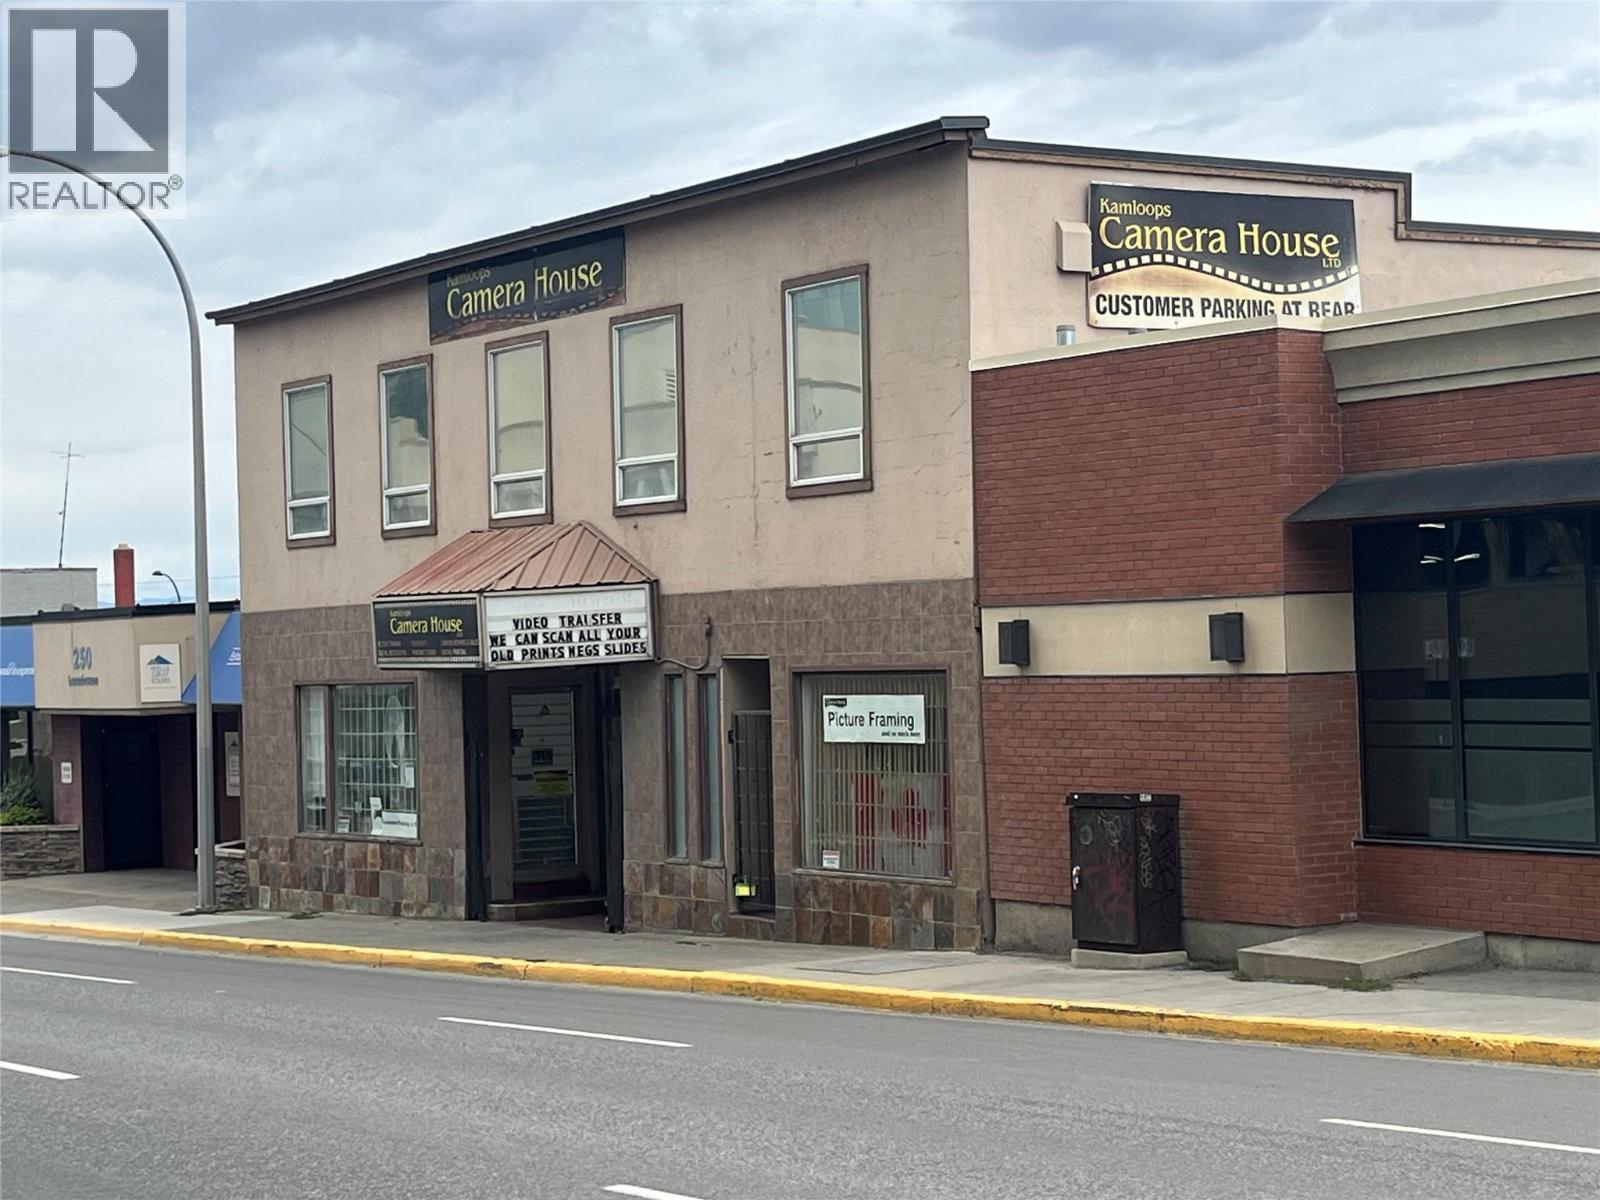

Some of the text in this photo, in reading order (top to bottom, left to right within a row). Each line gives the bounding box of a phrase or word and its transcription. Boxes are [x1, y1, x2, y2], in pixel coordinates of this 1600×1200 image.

[1100, 198, 1172, 220] Kamloops
[1100, 216, 1341, 258] Camera House
[1322, 258, 1342, 268] LTD
[447, 261, 603, 319] Camera House
[1096, 293, 1194, 317] CUSTOMER
[1201, 298, 1275, 318] PARKING
[1281, 301, 1302, 316] AT
[390, 616, 463, 635] Camera House
[513, 616, 548, 630] VIDEO
[515, 632, 538, 646] CAN
[542, 630, 573, 644] SCAN
[578, 628, 601, 643] ALL
[607, 627, 641, 640] YOUR
[73, 646, 93, 670] 250
[521, 646, 565, 661] PRINTS
[568, 644, 600, 658] NEGS
[604, 642, 647, 656] SLIDES
[828, 711, 915, 731] Picture Framing
